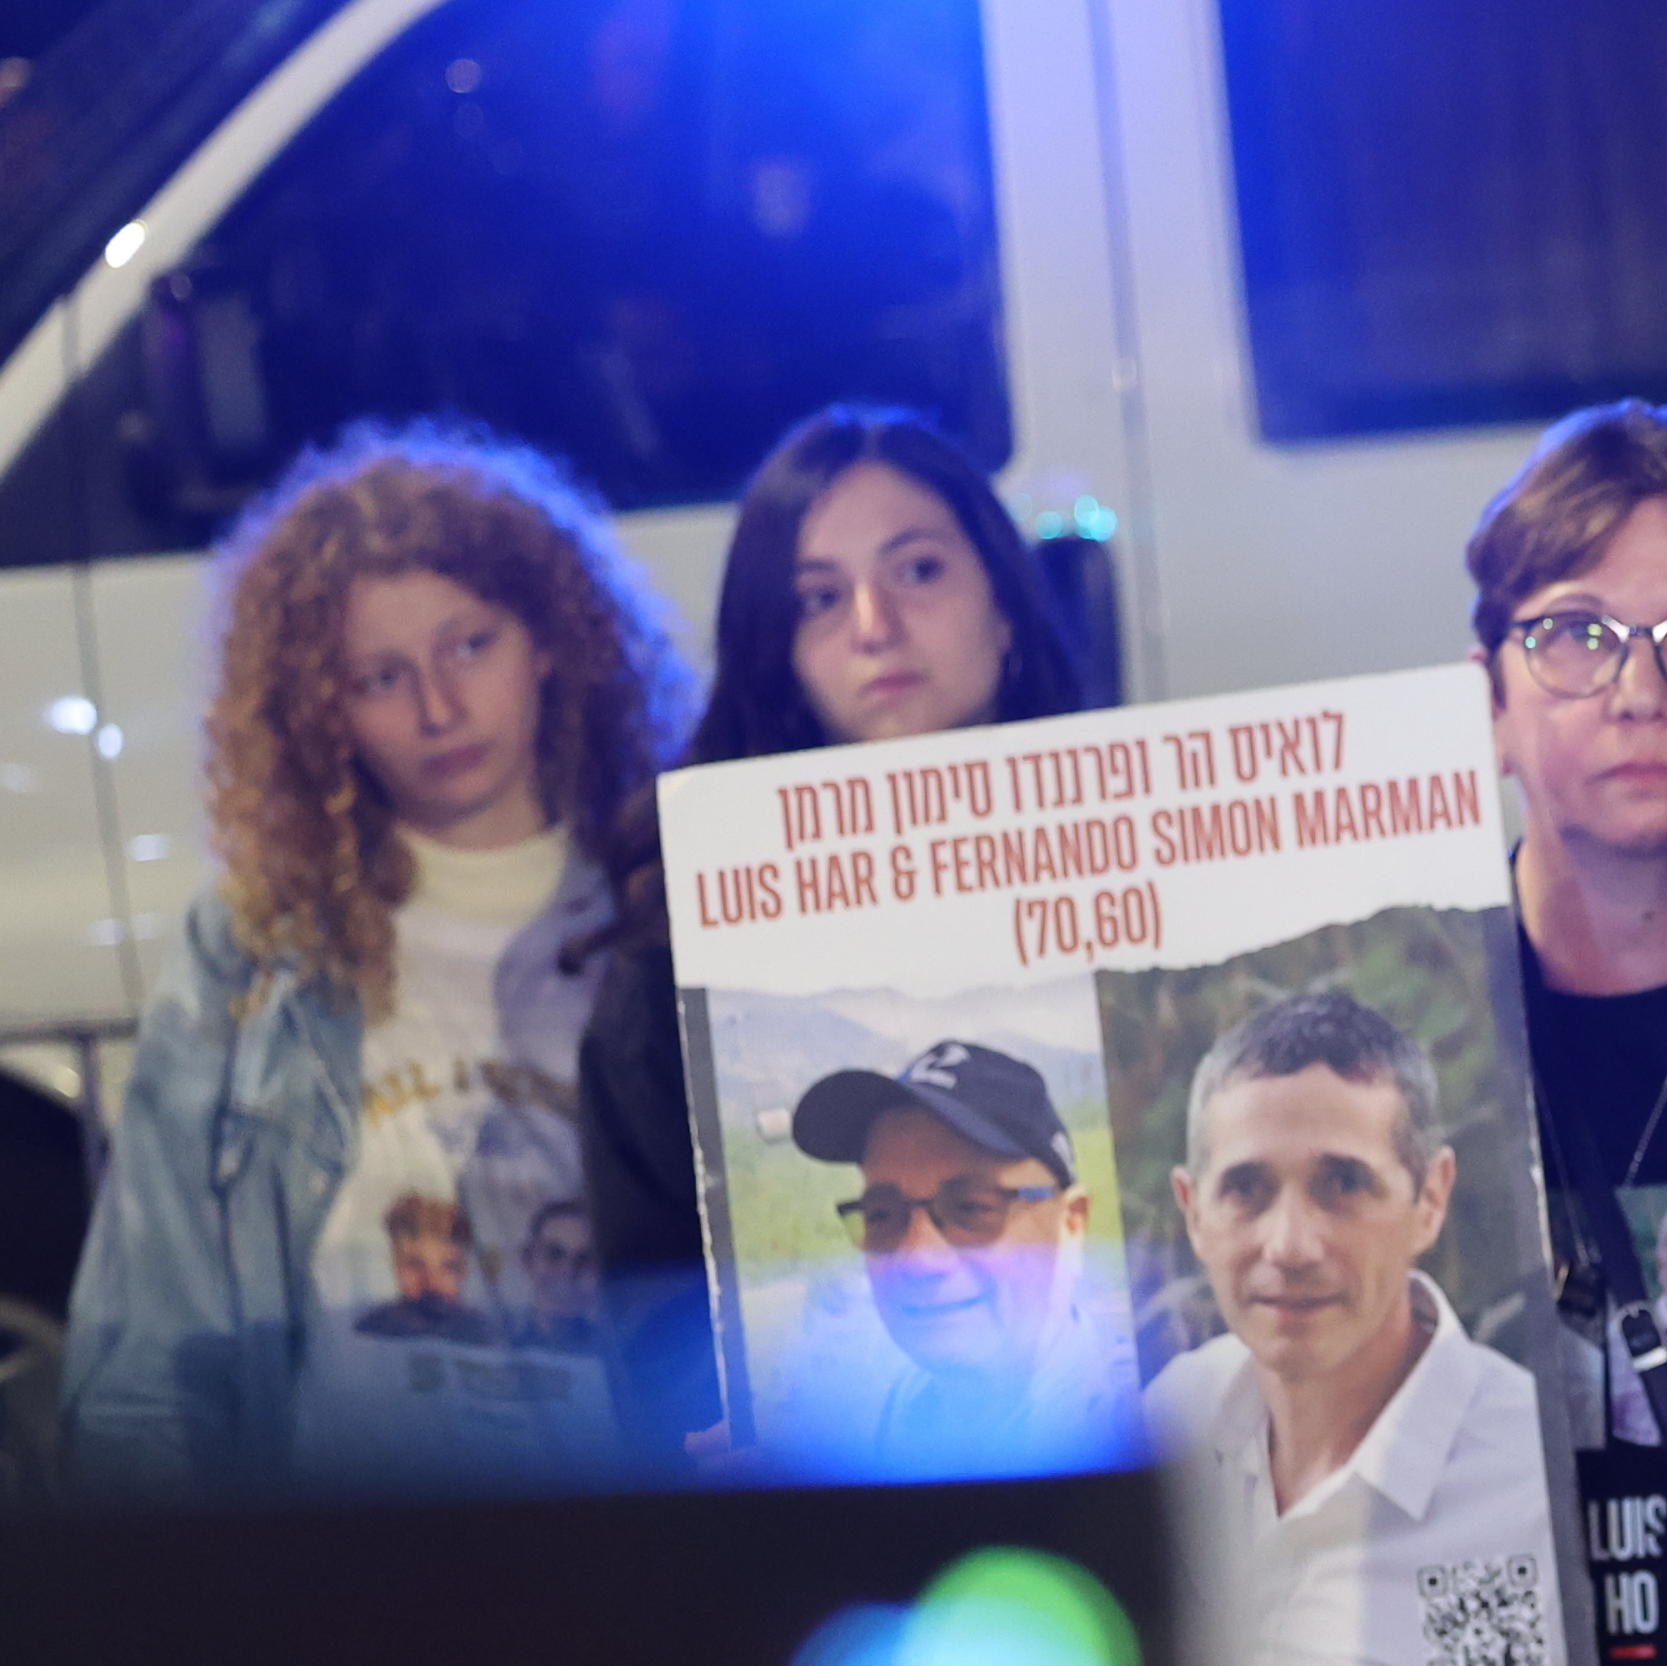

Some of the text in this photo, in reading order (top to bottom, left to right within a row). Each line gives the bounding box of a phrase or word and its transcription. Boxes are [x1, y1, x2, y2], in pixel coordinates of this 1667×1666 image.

[696, 770, 1481, 929] LUIS HAR & FERNANDO SIMON MARMAN
[777, 710, 1344, 851] לואיס הר ופרננדו סימון מרמן
[1014, 880, 1162, 966] (70,60)
